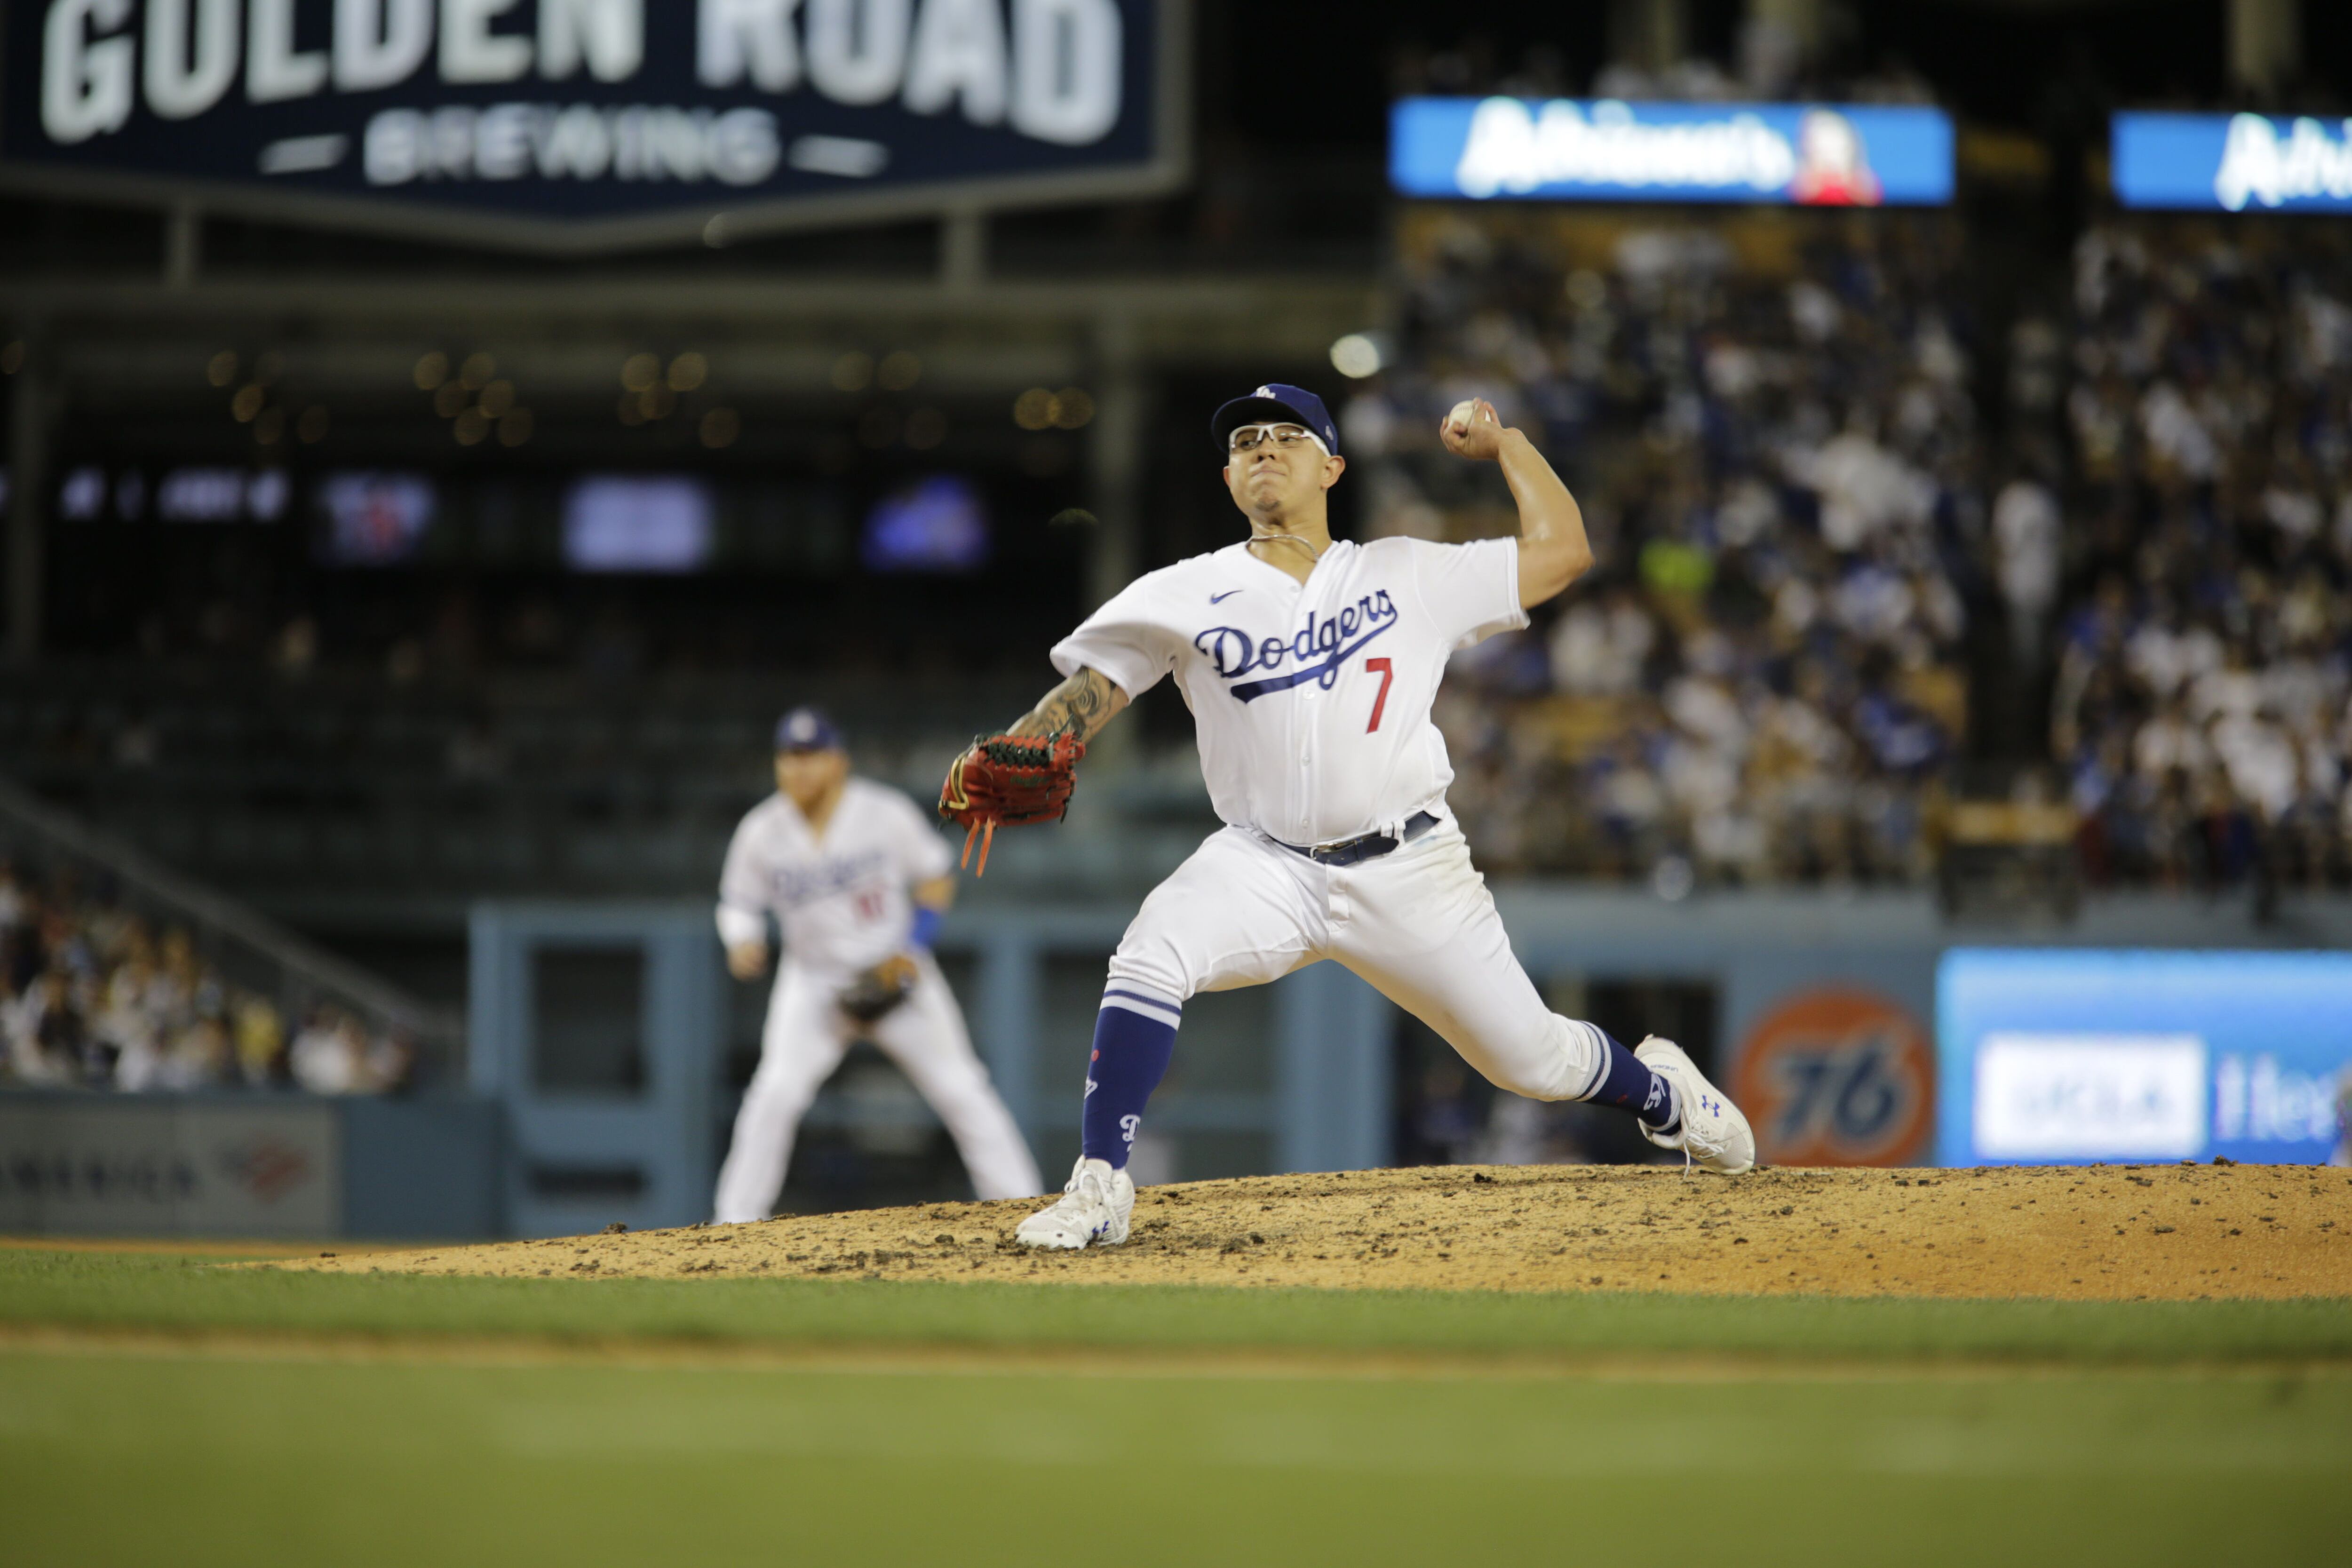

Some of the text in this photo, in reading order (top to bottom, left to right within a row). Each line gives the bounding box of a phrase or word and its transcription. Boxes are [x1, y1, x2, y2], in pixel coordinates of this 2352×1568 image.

[40, 0, 1124, 146] GOLDEN ROAD
[364, 103, 782, 186] BREWING
[1195, 589, 1397, 704] Dodgers
[1366, 658, 1393, 734] 7
[1771, 1033, 1903, 1141] 76
